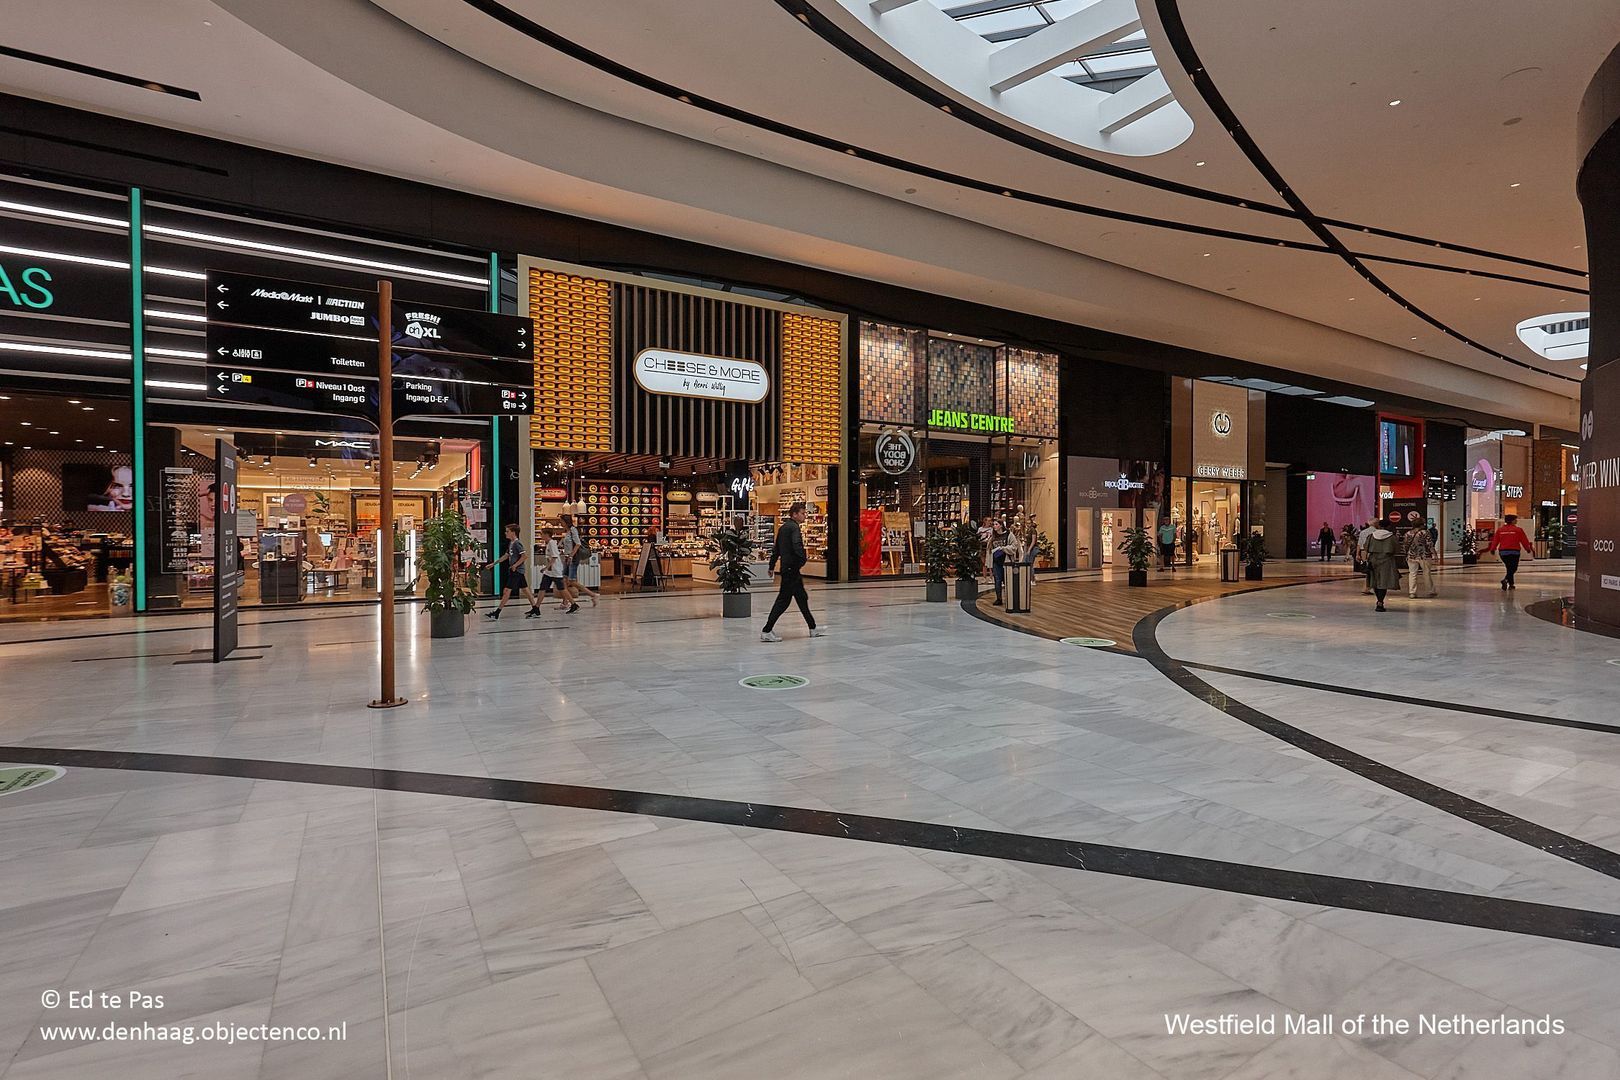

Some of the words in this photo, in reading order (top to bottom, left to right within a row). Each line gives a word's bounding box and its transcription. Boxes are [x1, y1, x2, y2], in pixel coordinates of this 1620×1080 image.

[310, 311, 350, 324] JUMBO
[422, 327, 442, 339] XL
[330, 357, 365, 368] Toiletten
[643, 357, 706, 375] CHEESE
[708, 364, 718, 376] &
[720, 366, 760, 381] MORE
[316, 381, 343, 392] Niveau
[348, 384, 366, 393] Oost
[405, 382, 432, 392] Parking
[682, 378, 690, 390] by
[332, 393, 358, 405] Ingang
[358, 395, 366, 404] G
[405, 394, 429, 403] Ingang
[430, 395, 449, 403] D-E-F
[927, 409, 969, 429] JEANS
[970, 413, 1015, 433] CENTRE
[1197, 466, 1219, 475] GERRY
[1222, 468, 1245, 478] WEBER
[731, 477, 754, 499] Gifts
[1506, 485, 1523, 498] STEPS
[1593, 539, 1614, 552] ecco
